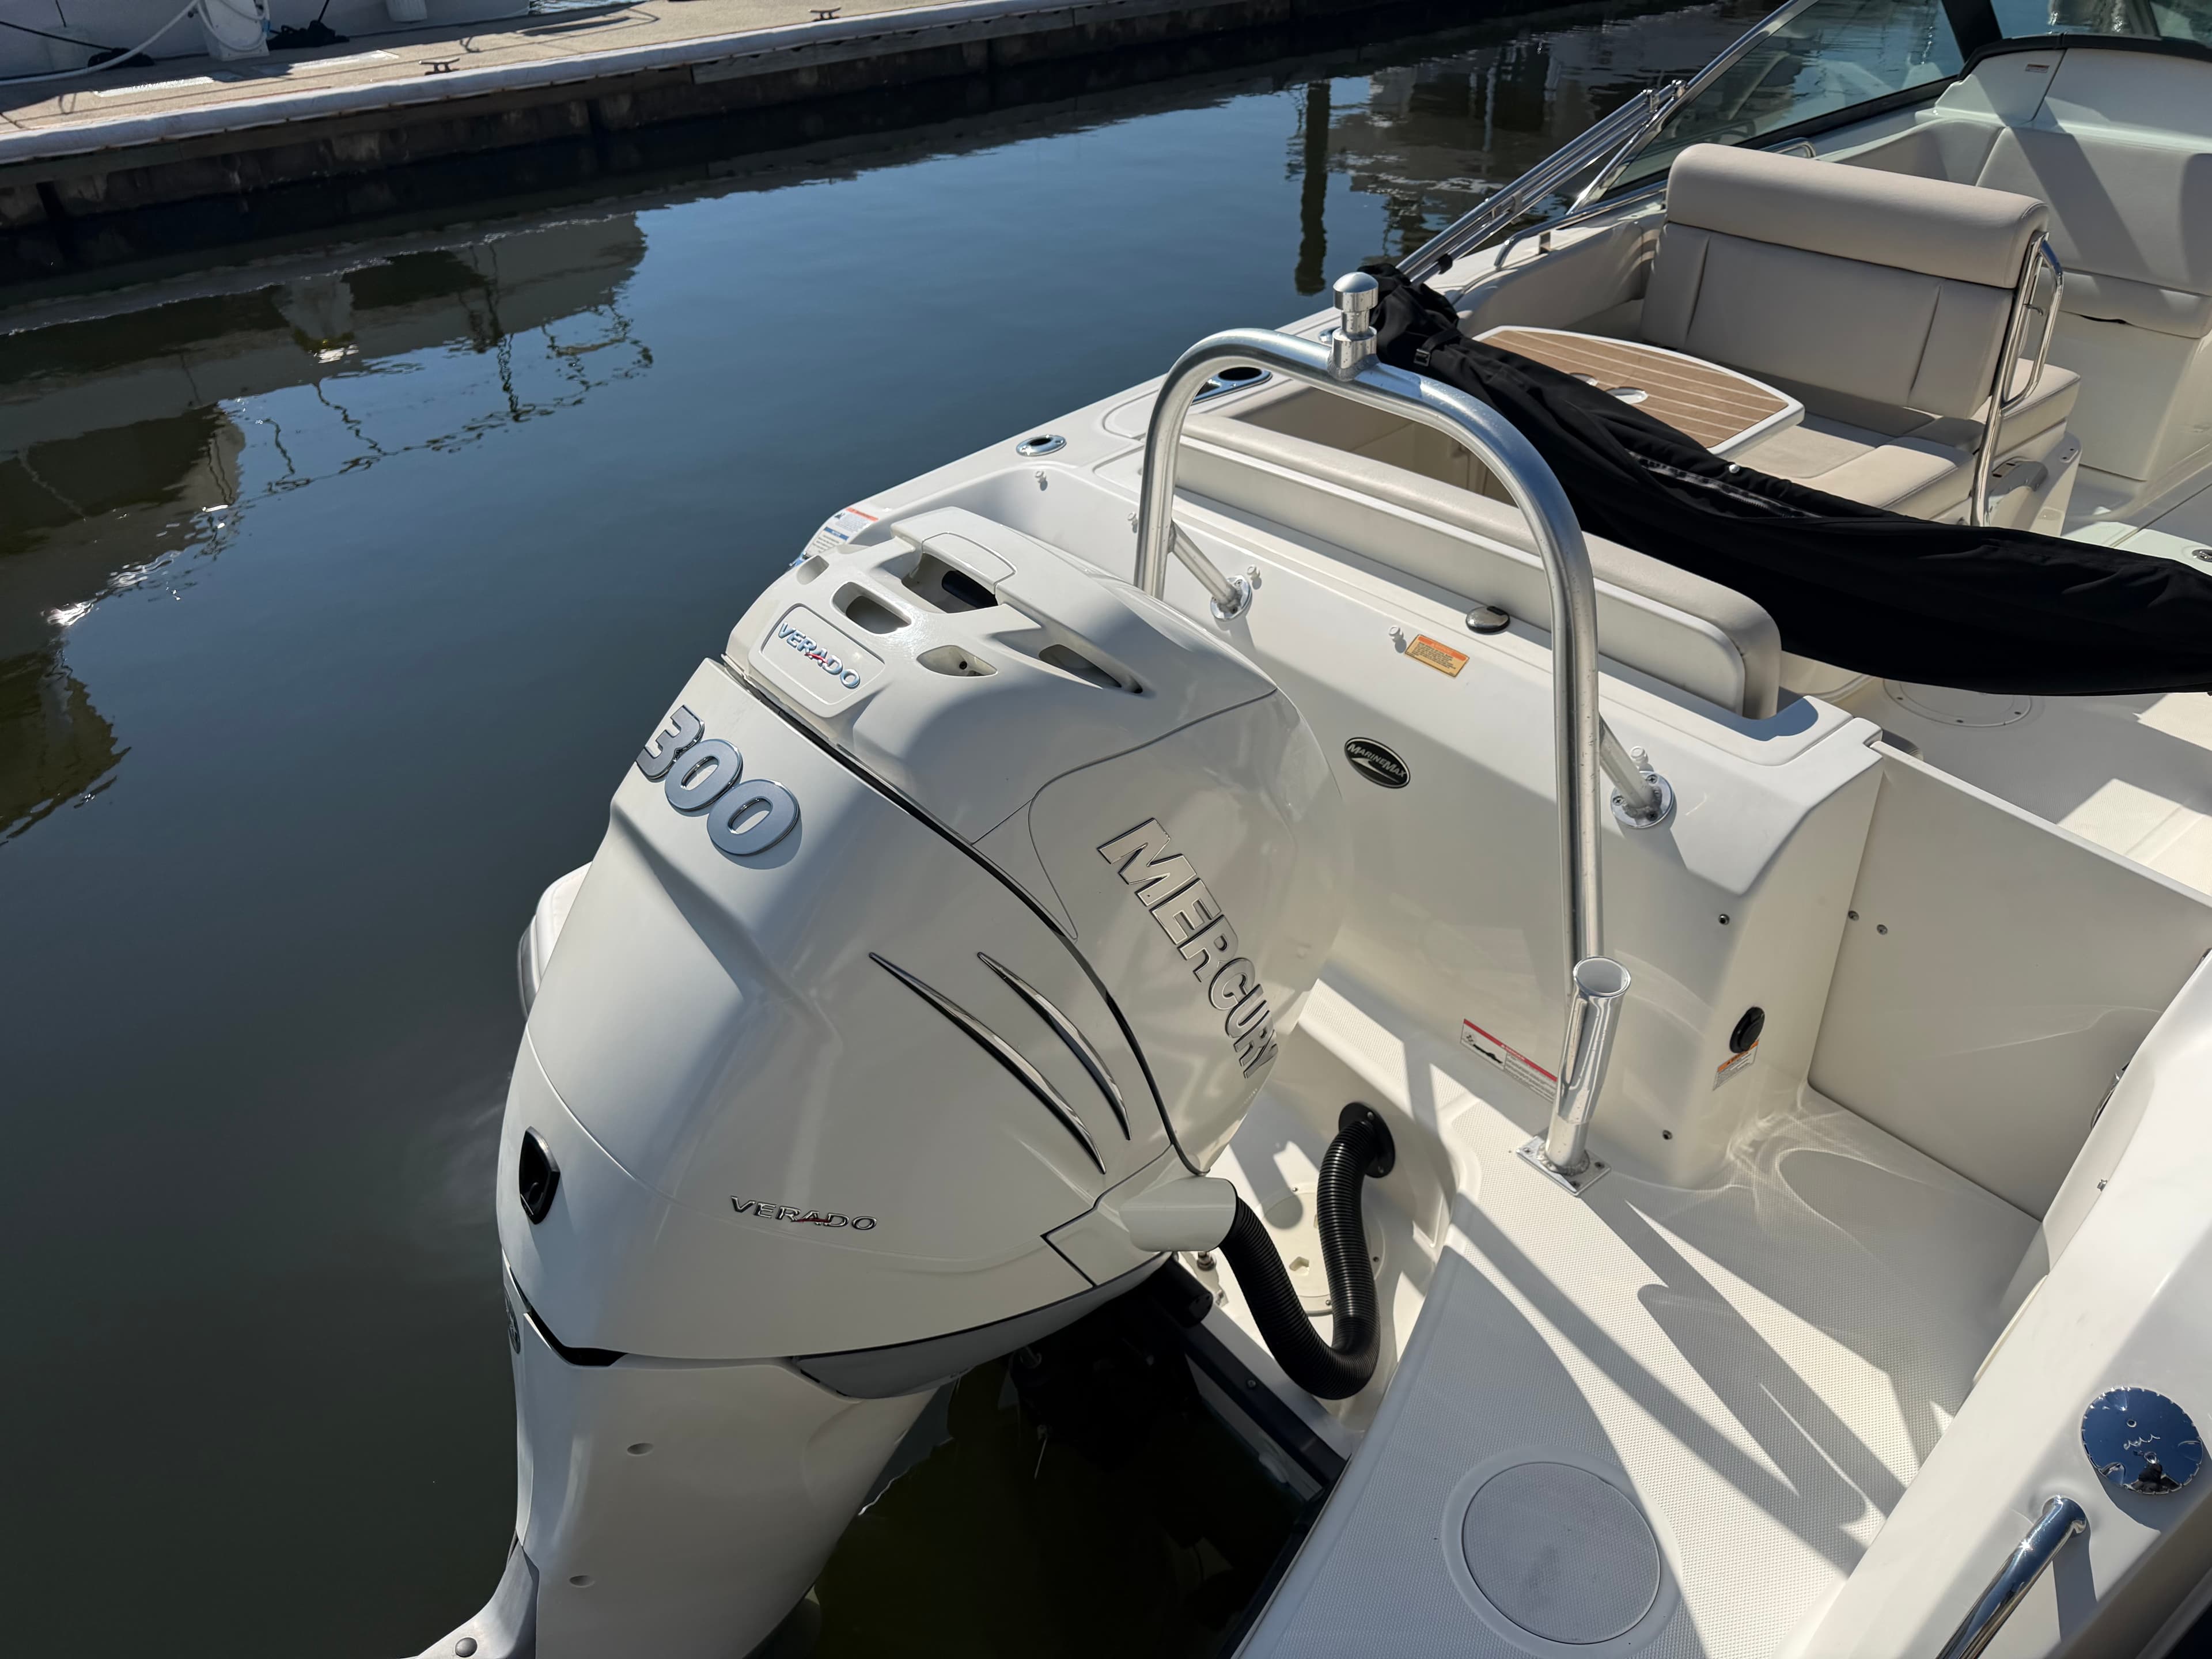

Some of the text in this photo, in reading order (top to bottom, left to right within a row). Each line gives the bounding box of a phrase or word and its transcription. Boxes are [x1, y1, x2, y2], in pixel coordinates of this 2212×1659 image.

[778, 622, 861, 689] VERADO
[636, 704, 800, 856] 300
[1097, 818, 1278, 1079] MERCURY
[730, 1195, 877, 1230] VERADO
